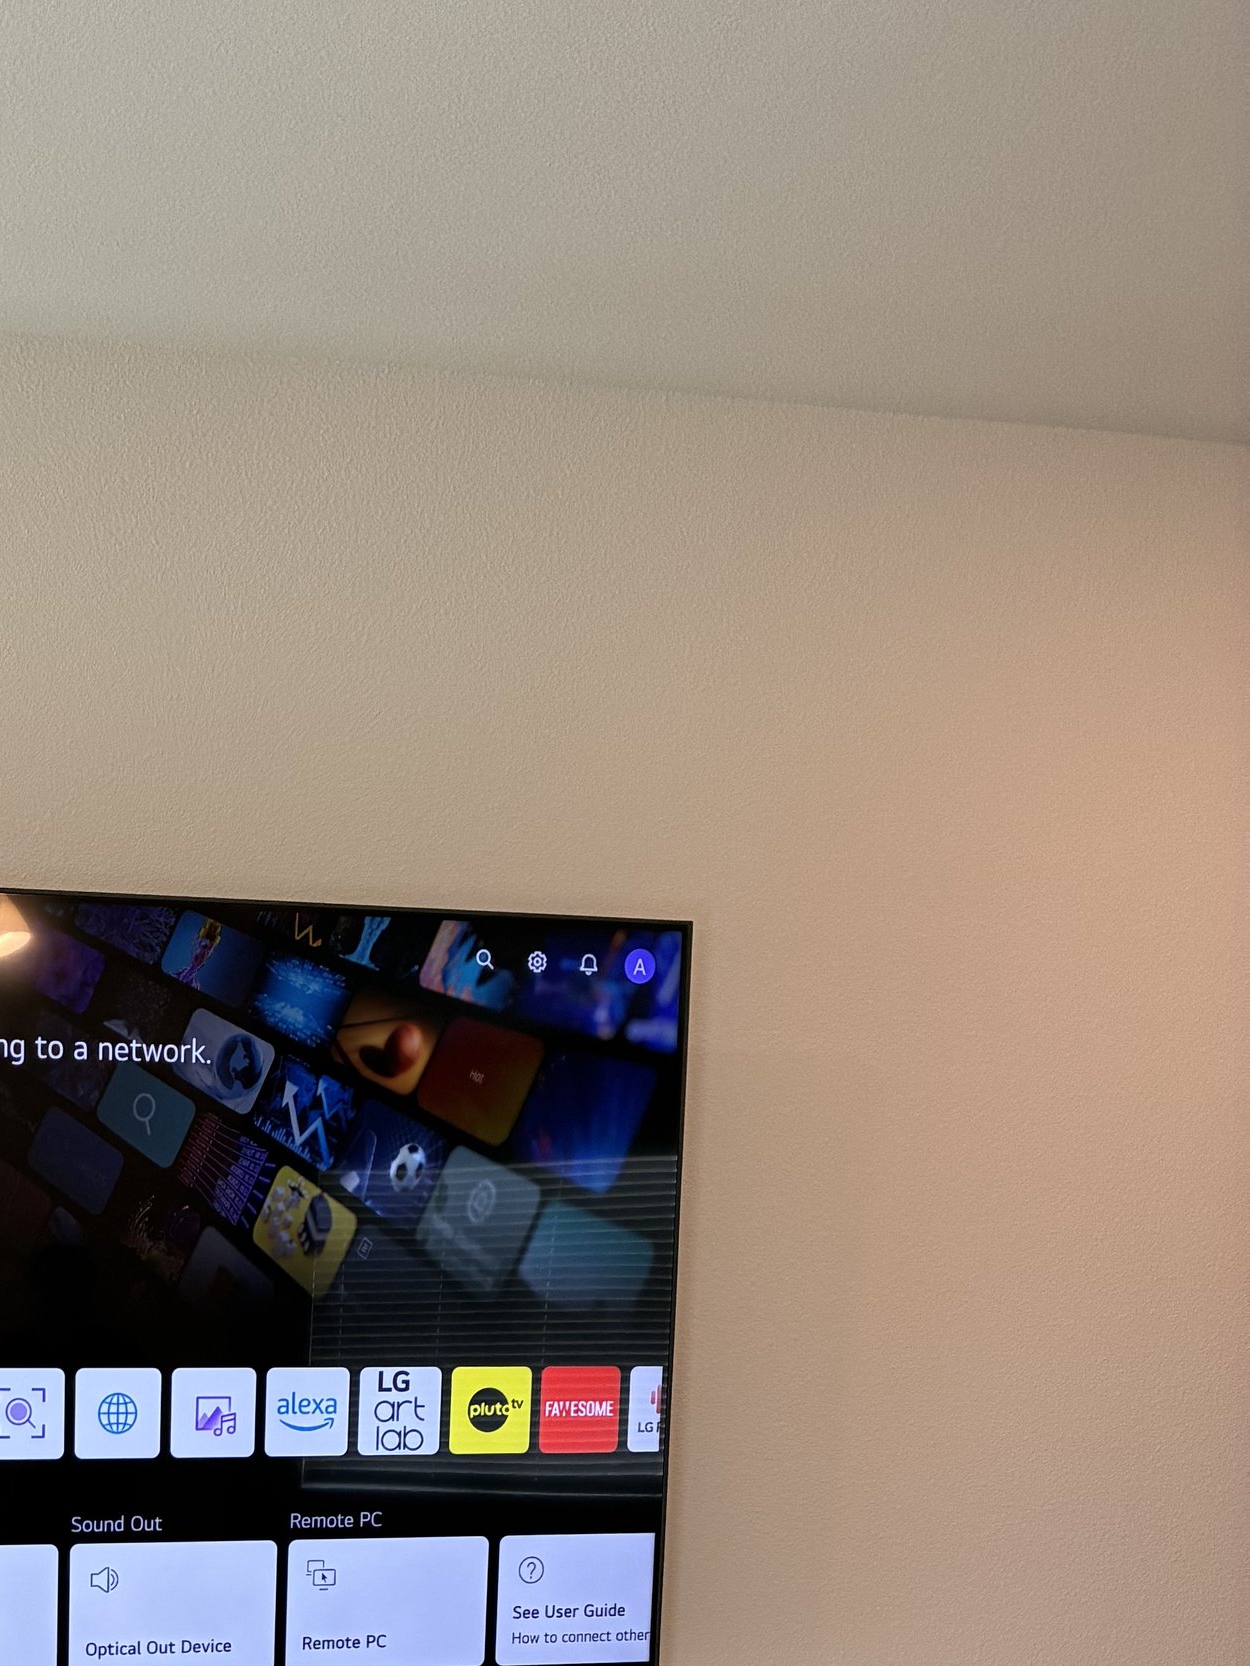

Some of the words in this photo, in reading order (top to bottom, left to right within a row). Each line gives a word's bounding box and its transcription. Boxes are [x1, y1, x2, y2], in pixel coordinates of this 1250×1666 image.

[633, 958, 646, 976] A
[34, 1036, 64, 1060] to
[73, 1041, 88, 1060] a
[98, 1037, 211, 1065] network.
[377, 1370, 411, 1393] LG
[276, 1391, 338, 1416] alexa
[373, 1396, 426, 1423] art
[510, 1398, 524, 1410] tv
[637, 1421, 654, 1433] LG
[375, 1425, 424, 1452] lab
[71, 1514, 125, 1533] Sound
[130, 1515, 163, 1532] Out
[290, 1512, 354, 1529] Remote
[360, 1511, 383, 1528] PC
[512, 1605, 540, 1620] See
[544, 1604, 580, 1619] User
[583, 1602, 626, 1618] Guide
[302, 1636, 361, 1651] Remote
[366, 1634, 387, 1649] PC
[511, 1631, 540, 1645] How
[543, 1632, 558, 1644] to
[561, 1630, 612, 1644] connect
[615, 1628, 650, 1642] other
[85, 1640, 142, 1660] Optical
[146, 1640, 176, 1655] Out
[181, 1638, 232, 1654] Device
